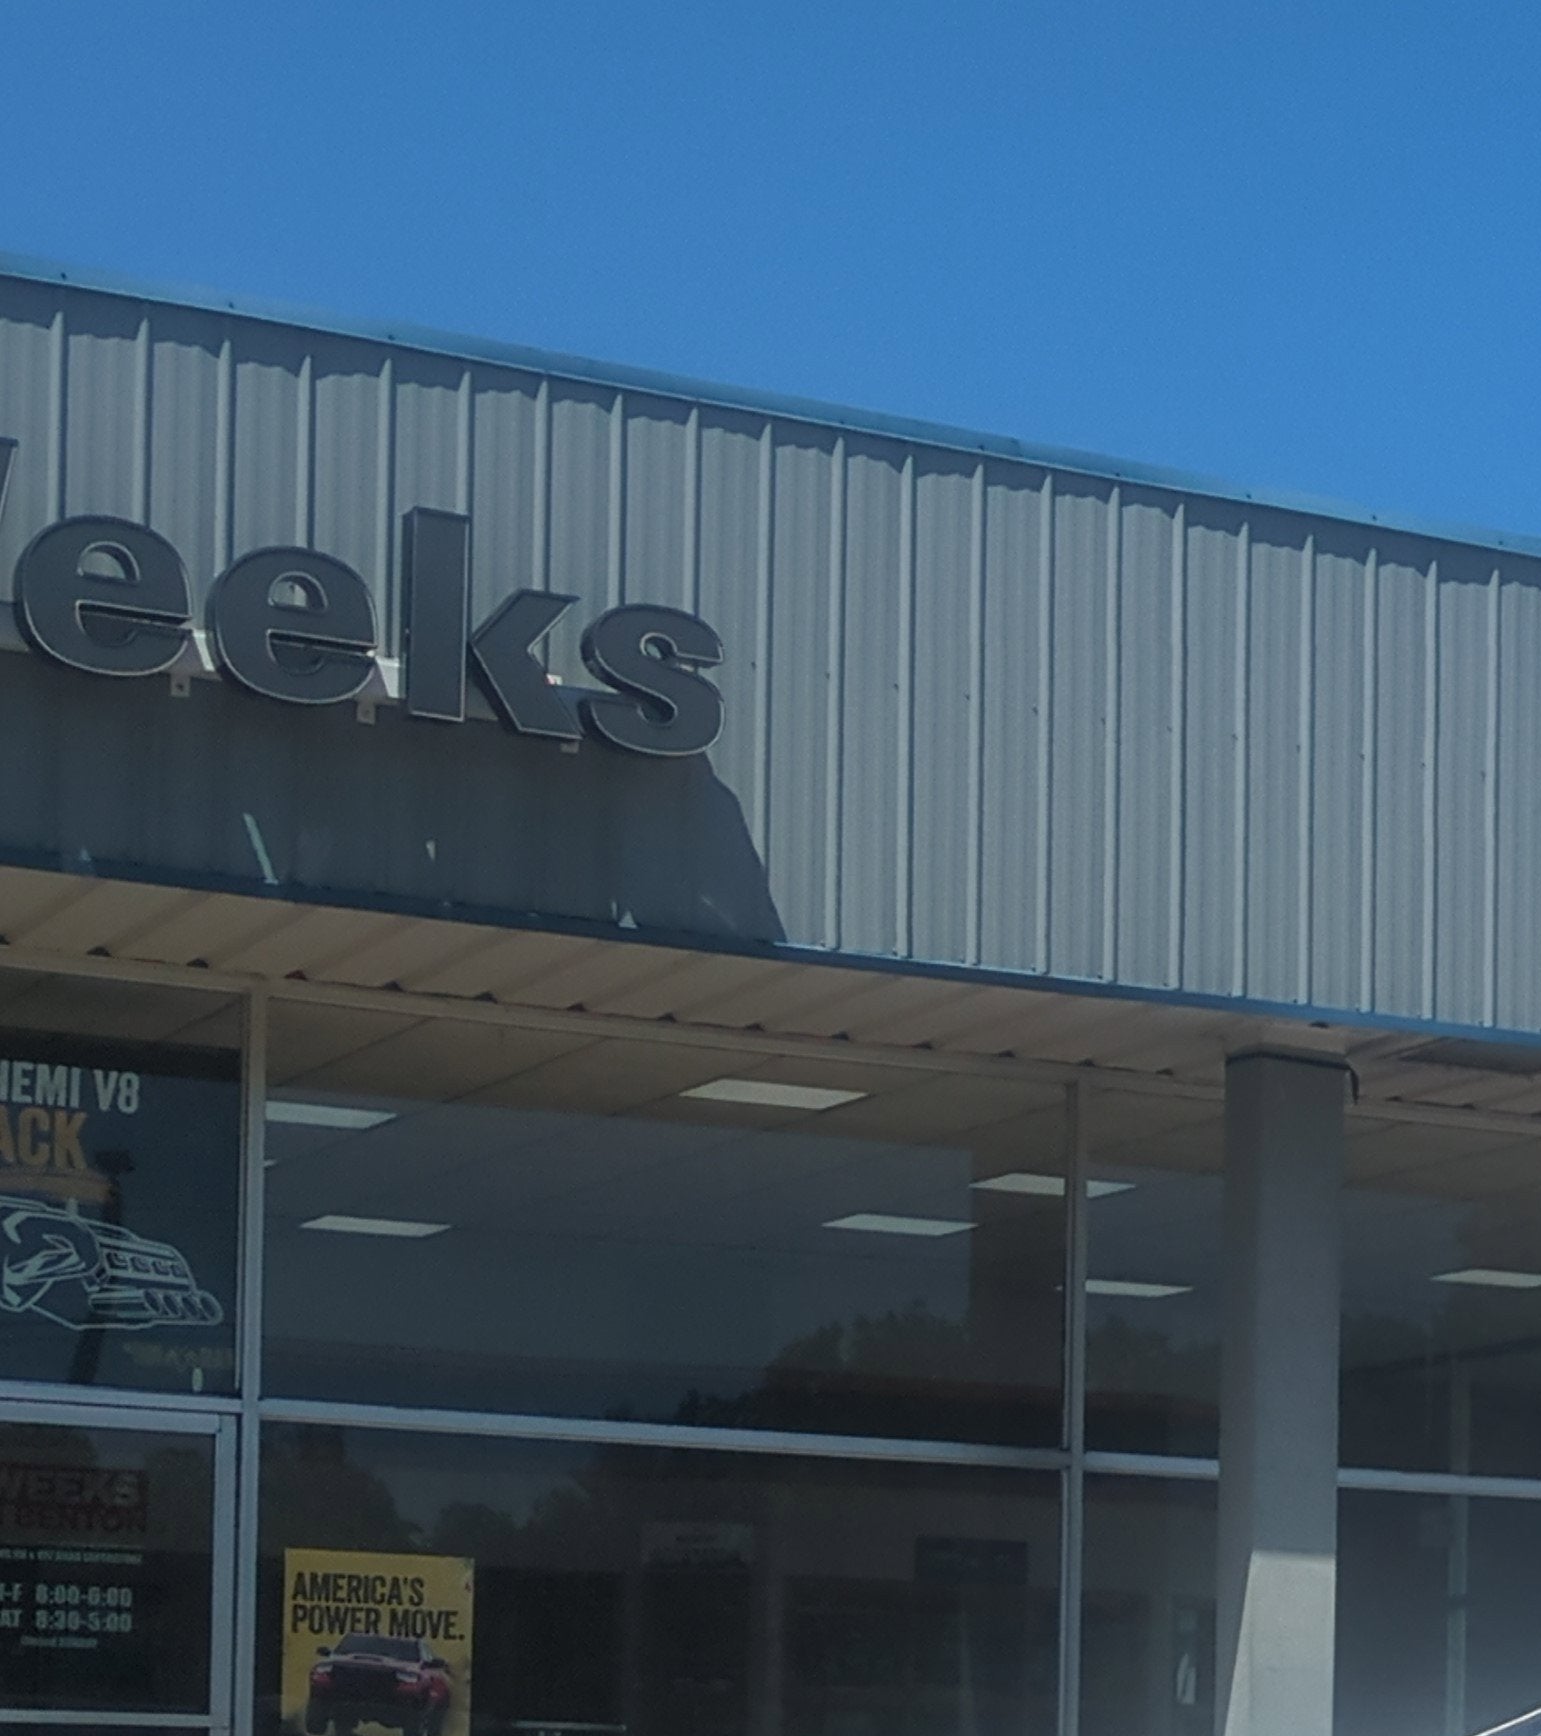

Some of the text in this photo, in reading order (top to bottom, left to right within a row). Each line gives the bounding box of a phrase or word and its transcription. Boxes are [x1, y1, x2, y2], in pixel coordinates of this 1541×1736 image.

[0, 437, 724, 757] eeks
[94, 1069, 140, 1114] V8
[292, 1572, 424, 1607] AMERICA'S
[291, 1603, 465, 1641] POWER MOVE.
